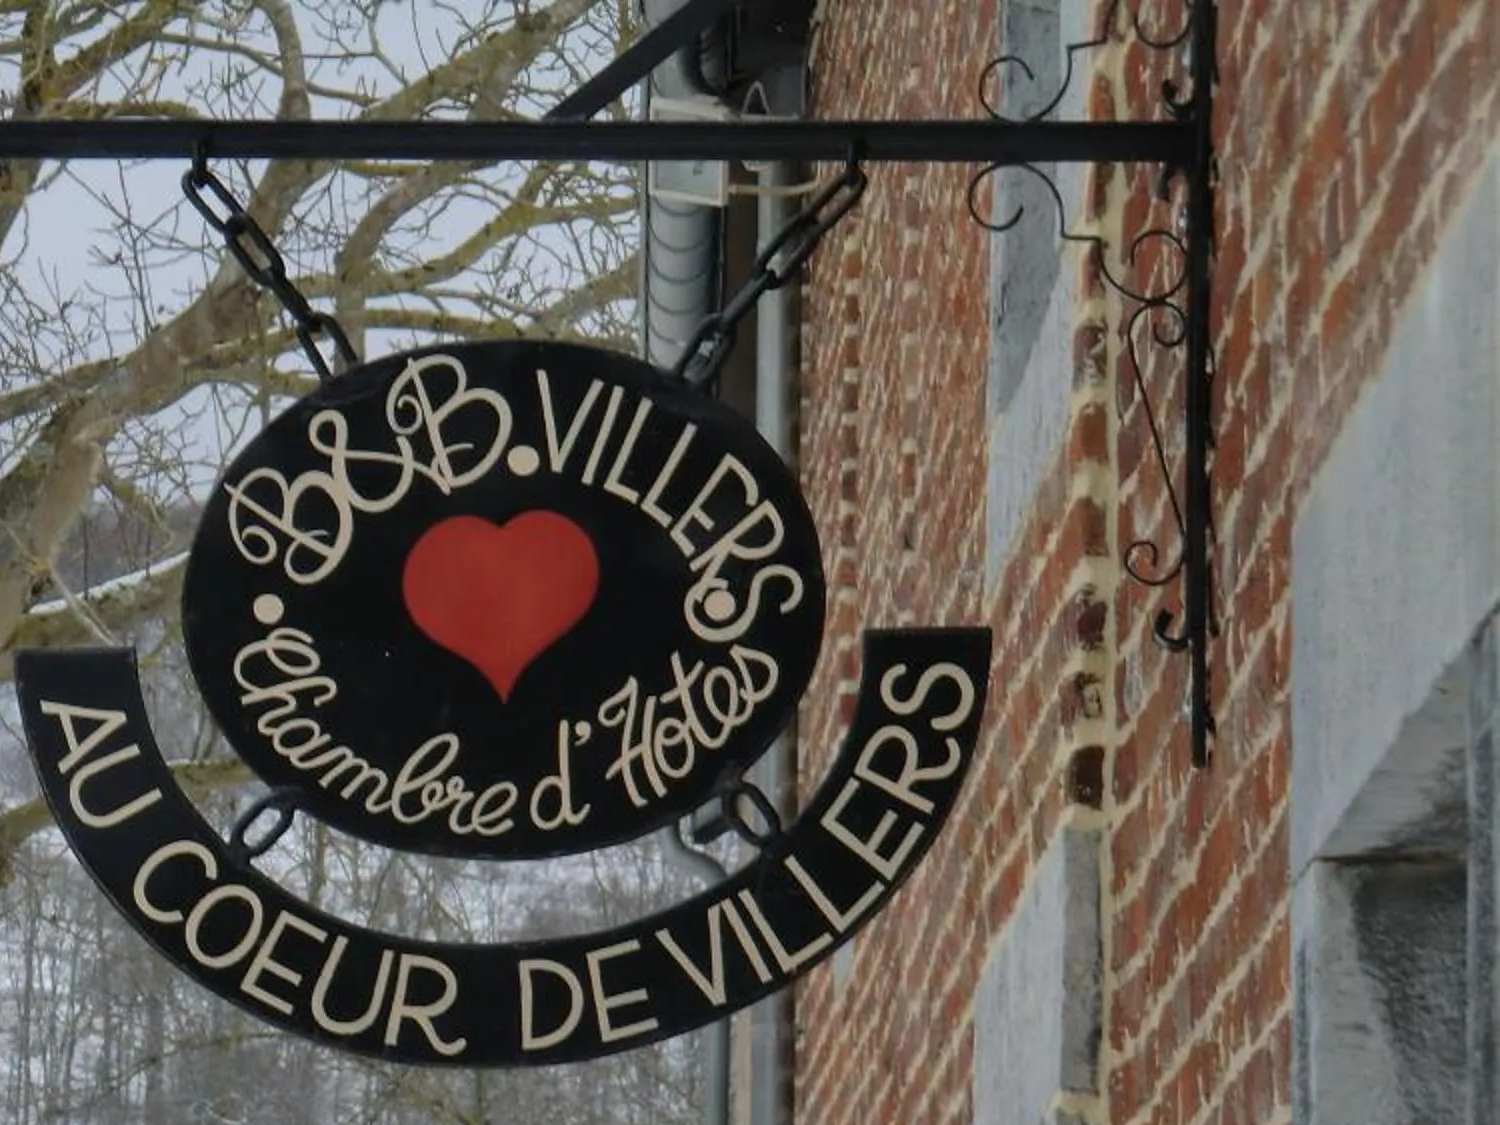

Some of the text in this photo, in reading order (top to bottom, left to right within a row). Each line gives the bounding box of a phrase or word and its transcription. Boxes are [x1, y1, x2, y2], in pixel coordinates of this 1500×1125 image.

[223, 353, 803, 643] B&B VILLERS
[40, 661, 976, 1057] AU COEUR DE VILLERS
[233, 627, 519, 837] Chambre
